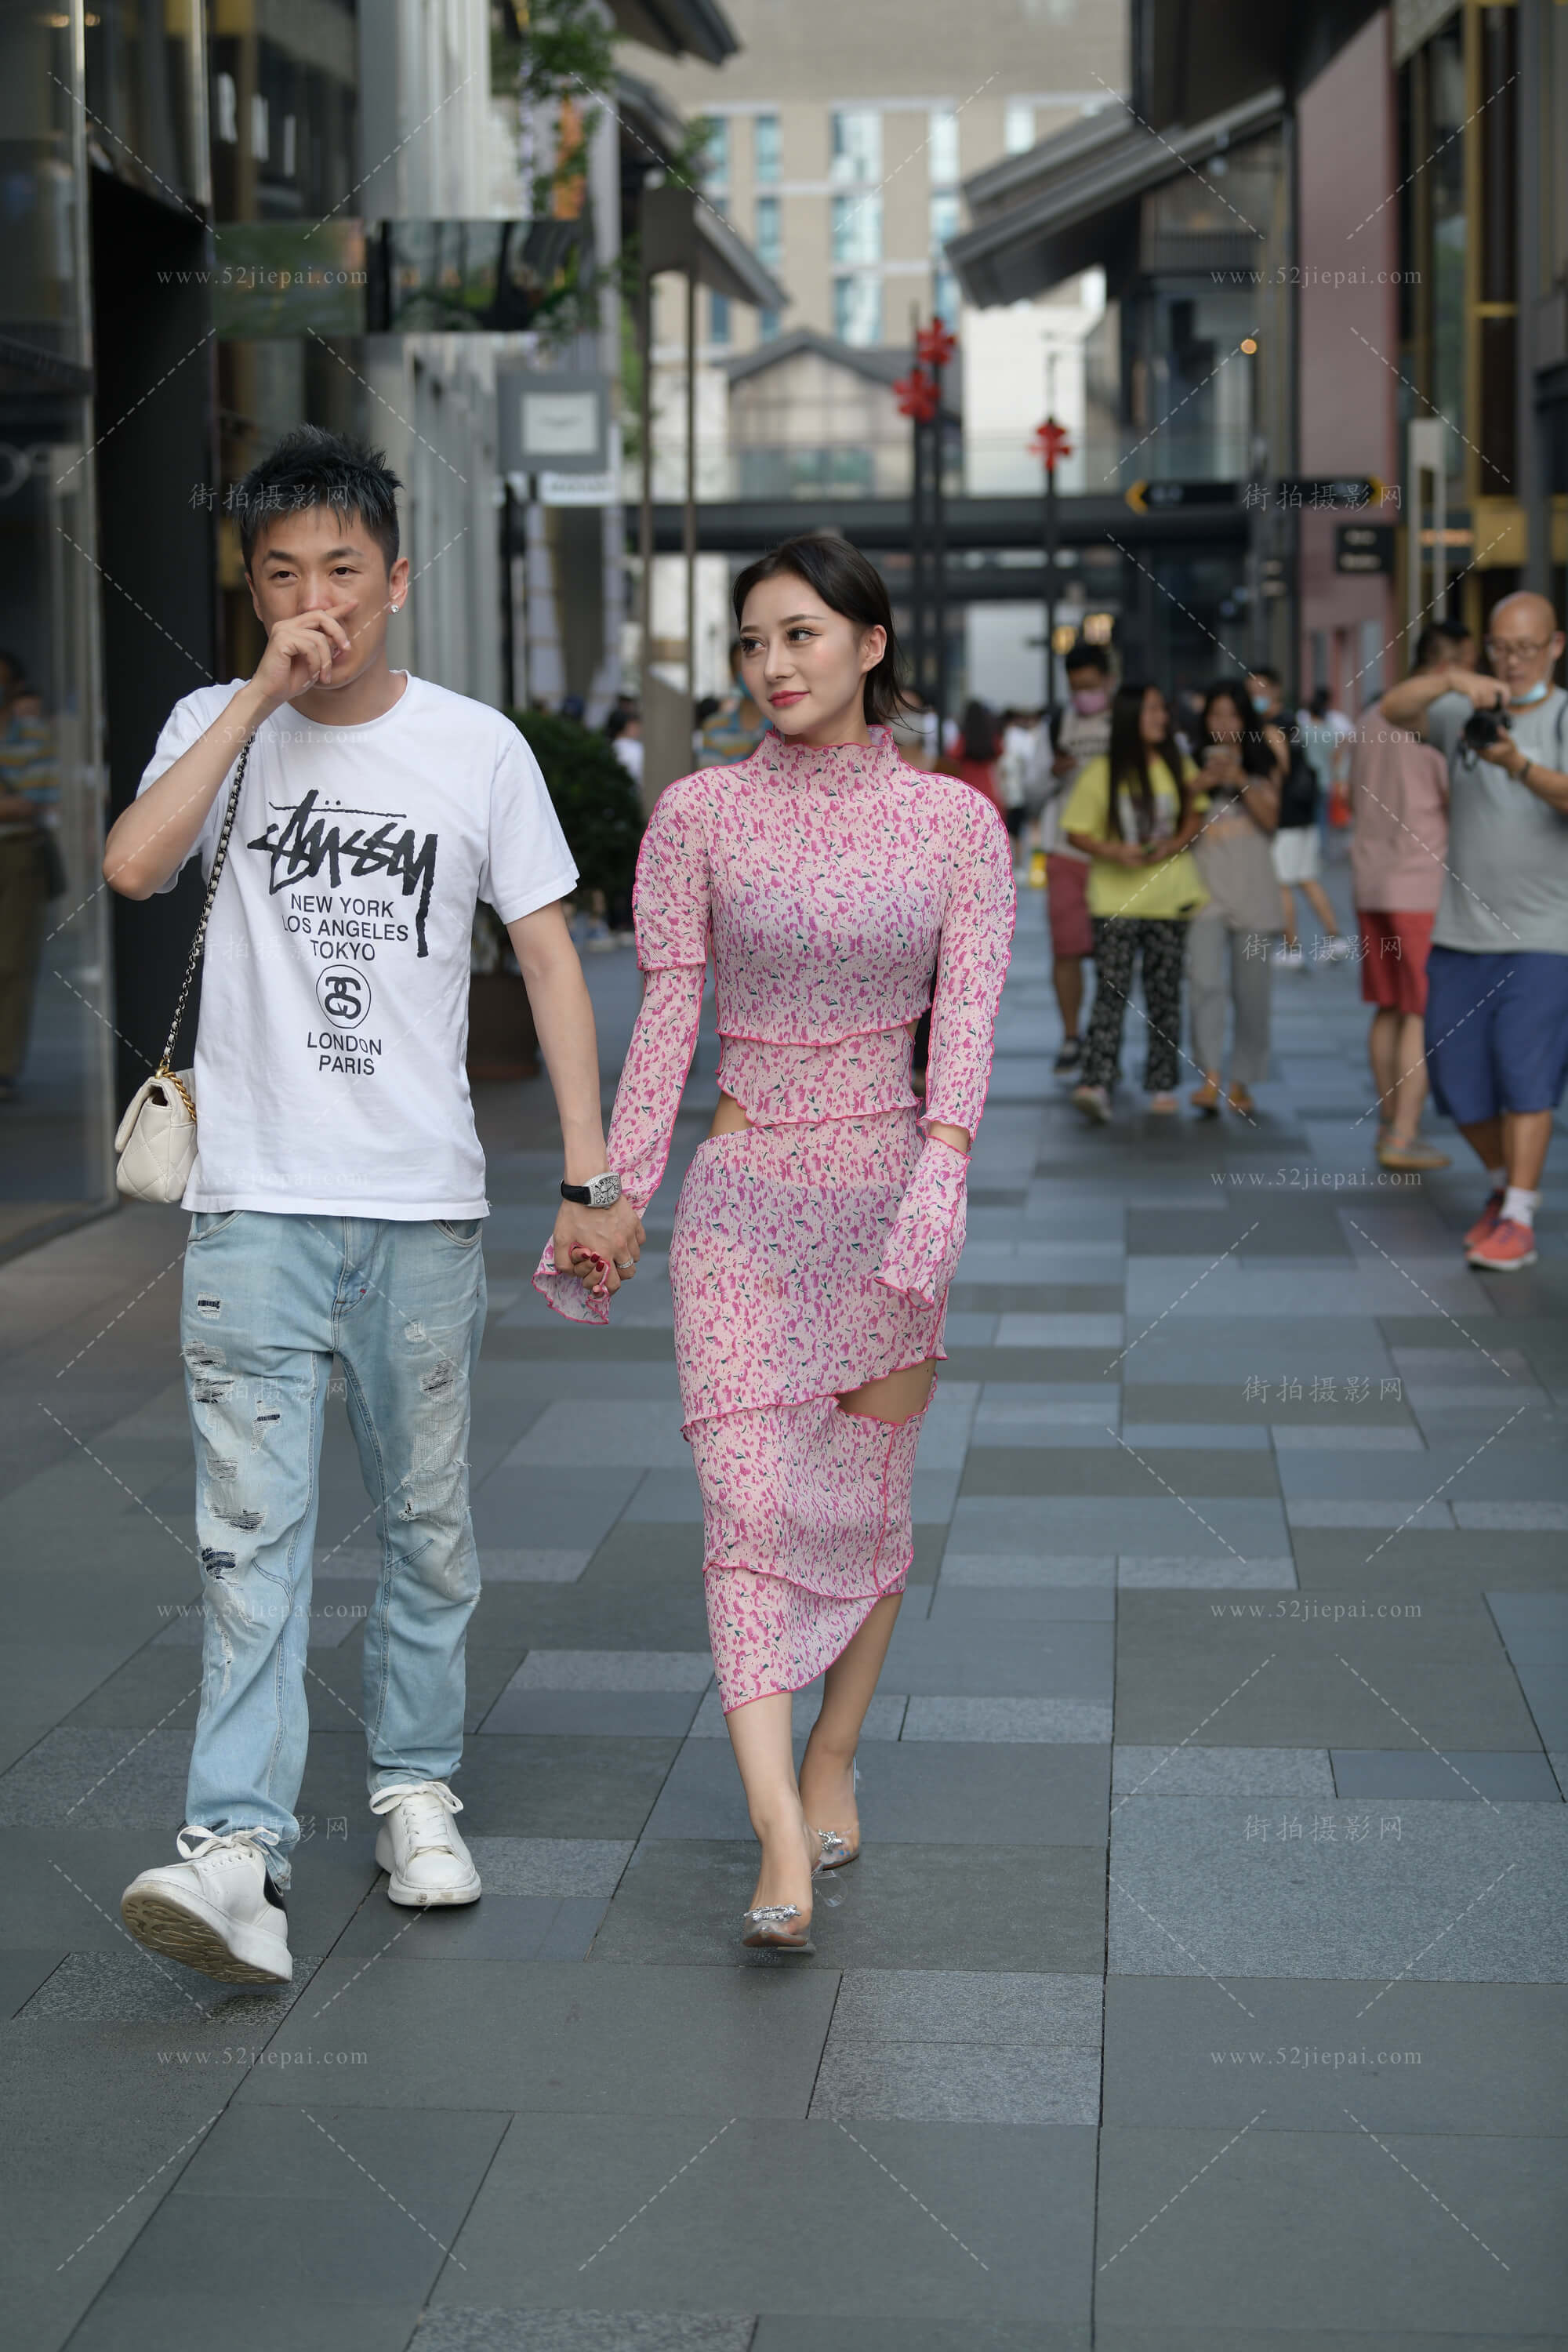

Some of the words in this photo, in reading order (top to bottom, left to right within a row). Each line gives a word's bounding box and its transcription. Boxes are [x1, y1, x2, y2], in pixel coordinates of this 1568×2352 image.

[291, 893, 333, 913] NEW
[339, 897, 395, 918] YORK
[282, 915, 312, 934] LOS
[318, 919, 408, 942] ANGELES
[310, 939, 376, 961] TOKYO
[307, 1032, 383, 1056] LONDON
[319, 1054, 375, 1075] PARIS
